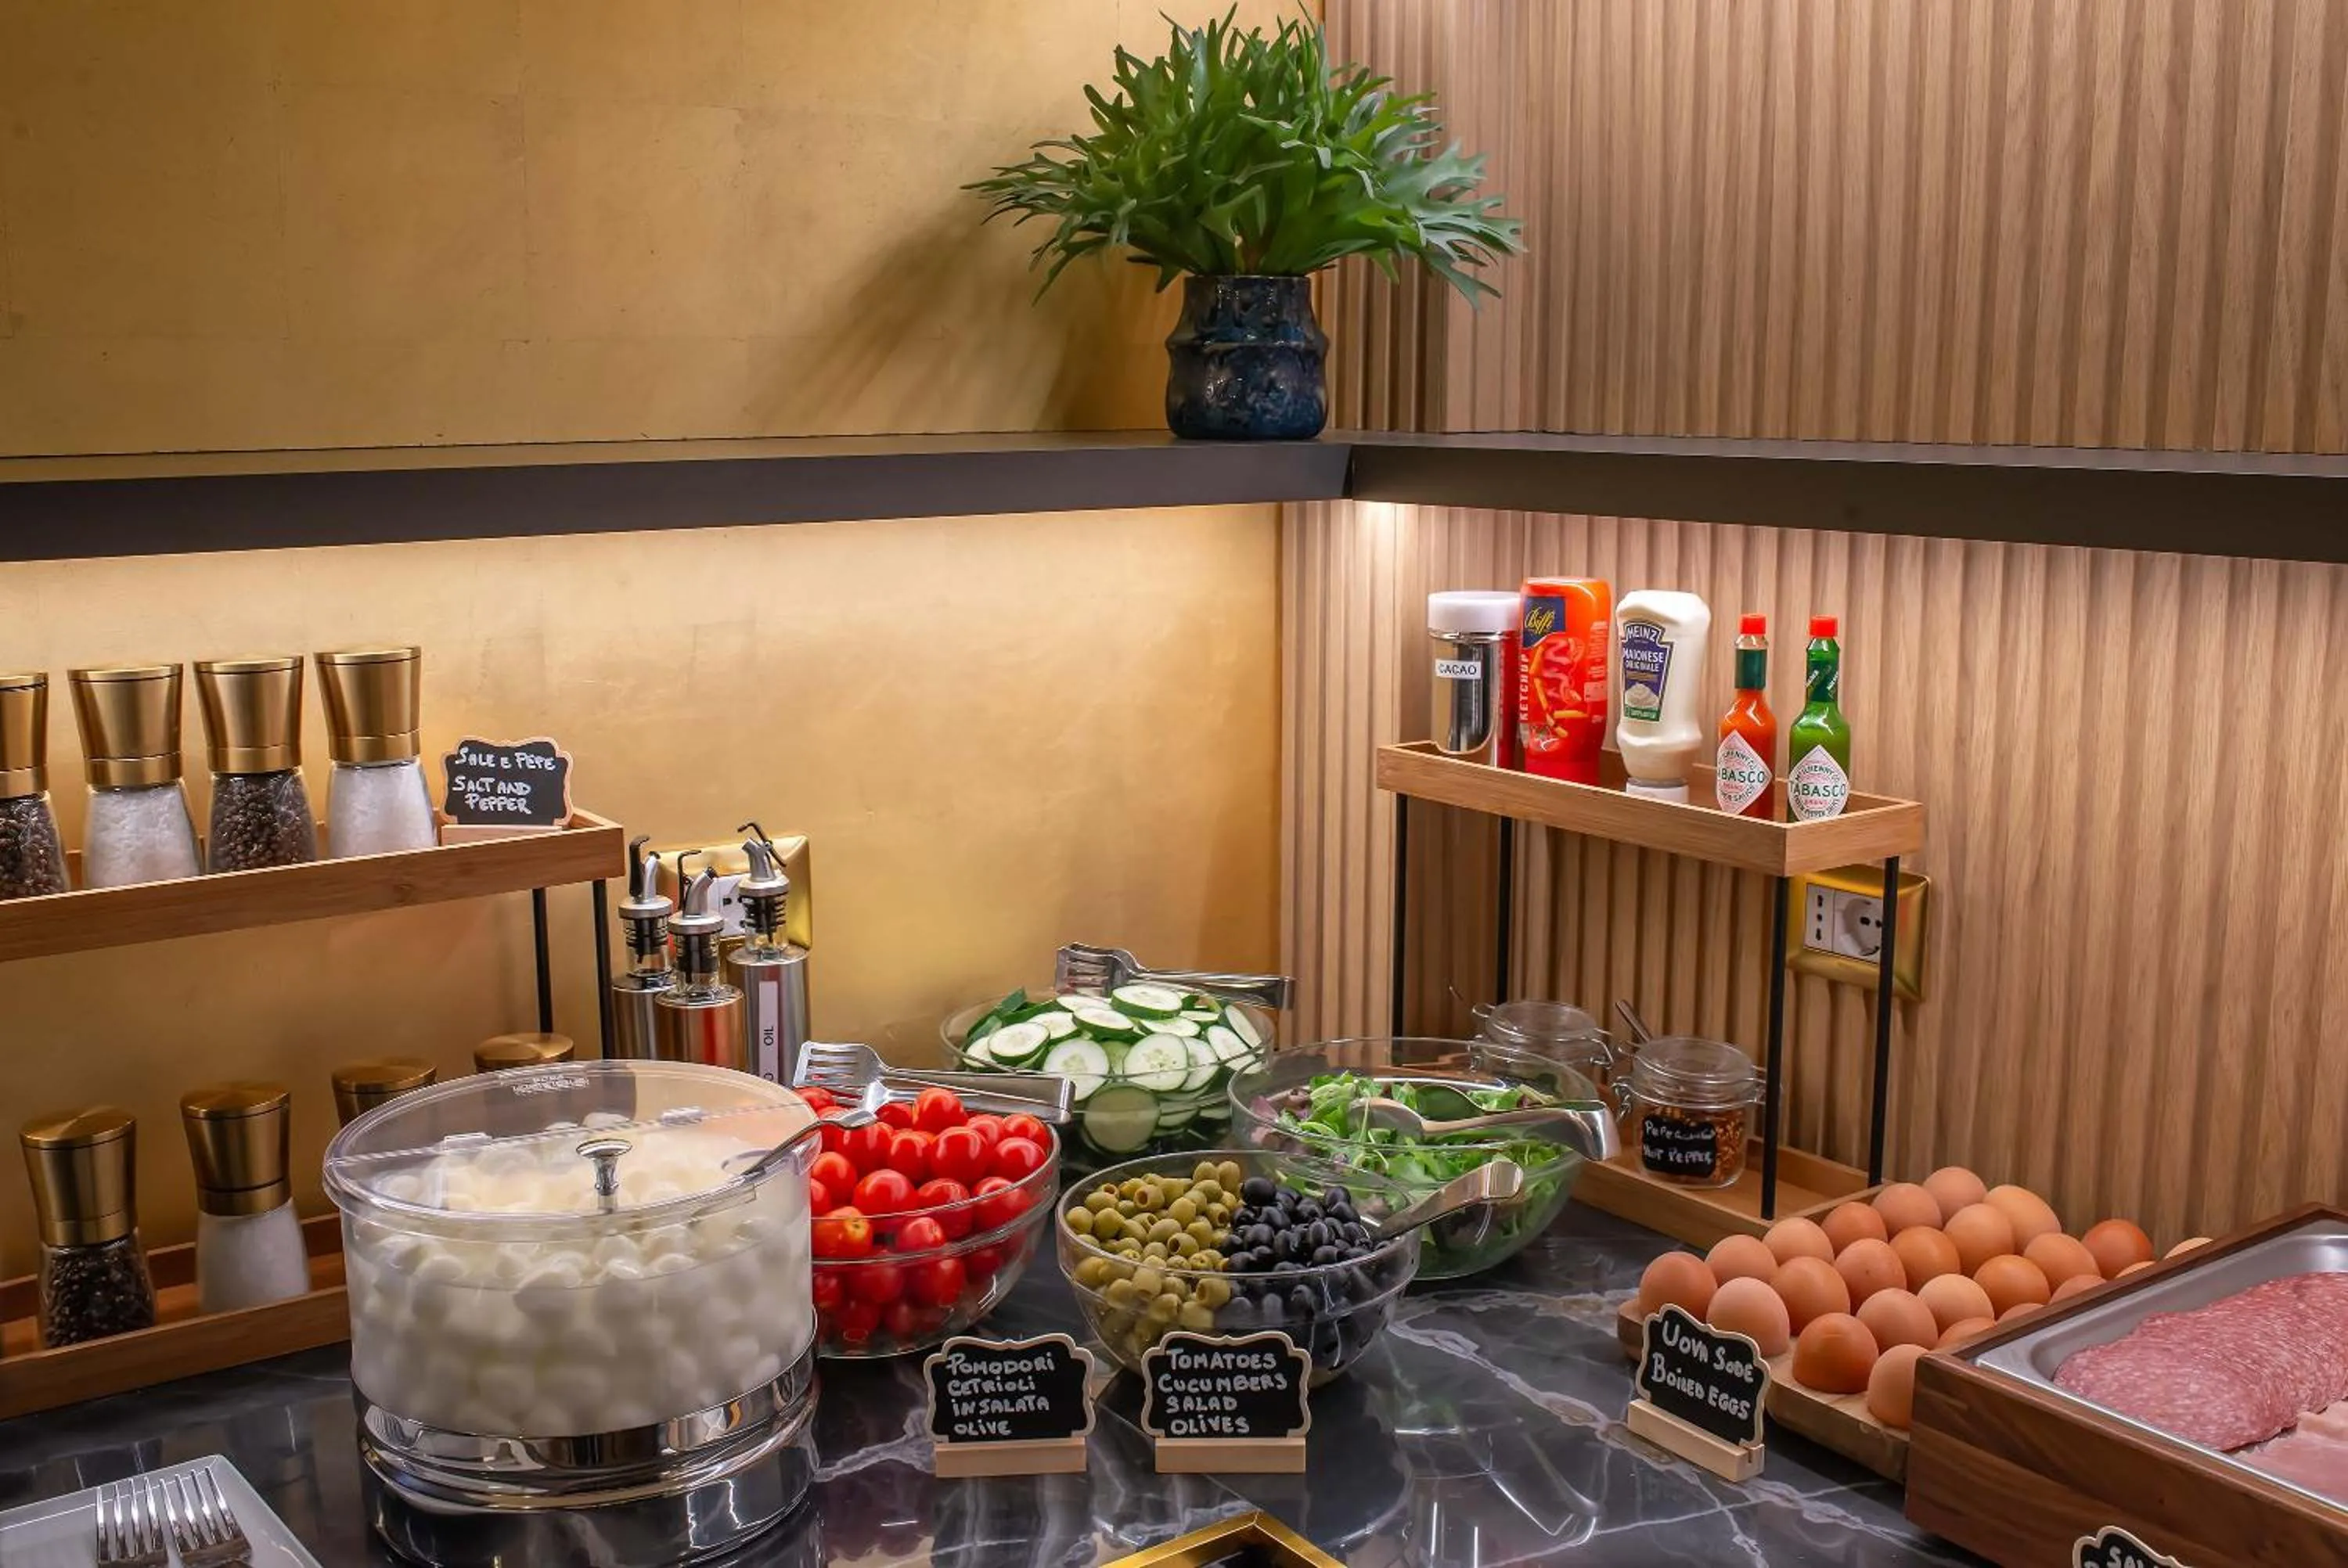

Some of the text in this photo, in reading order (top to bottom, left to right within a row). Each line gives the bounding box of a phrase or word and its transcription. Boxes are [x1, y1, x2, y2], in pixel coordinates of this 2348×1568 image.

[1627, 625, 1658, 642] HEINZ
[1439, 664, 1477, 675] CACAO
[1519, 653, 1529, 721] KETCHUP
[455, 746, 495, 768] SALE
[514, 751, 556, 771] PEPE
[452, 774, 531, 796] SALT AND
[1718, 768, 1766, 783] BASCO
[1790, 781, 1846, 797] TABASCO
[464, 793, 532, 815] PEPPER
[763, 1026, 774, 1046] OIL
[1166, 1347, 1277, 1370] TOMATOES
[1712, 1346, 1754, 1383] SODE
[1158, 1372, 1288, 1394] CUCUMBERS
[1165, 1395, 1238, 1415] SALAD
[1707, 1386, 1752, 1421] EGGS
